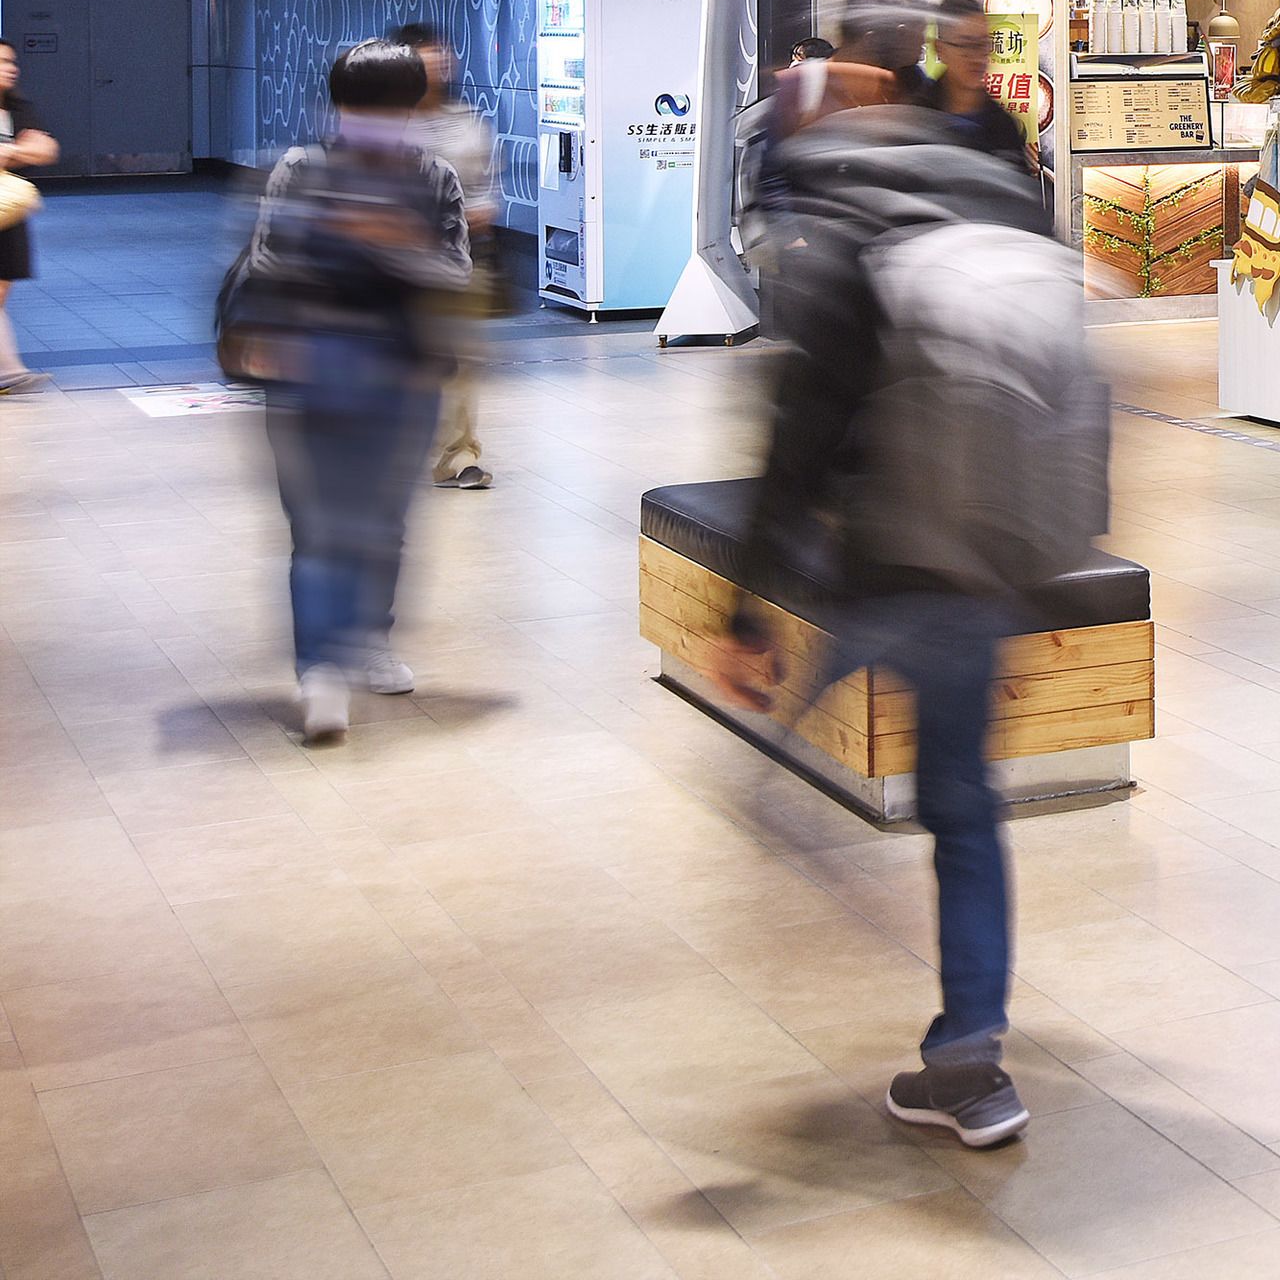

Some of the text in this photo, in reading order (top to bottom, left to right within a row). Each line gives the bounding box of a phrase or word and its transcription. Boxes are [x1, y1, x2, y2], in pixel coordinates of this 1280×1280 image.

[1000, 102, 1030, 113] 早餐
[1179, 114, 1193, 122] THE
[1169, 122, 1204, 131] GREENERY
[1180, 130, 1195, 138] BAR
